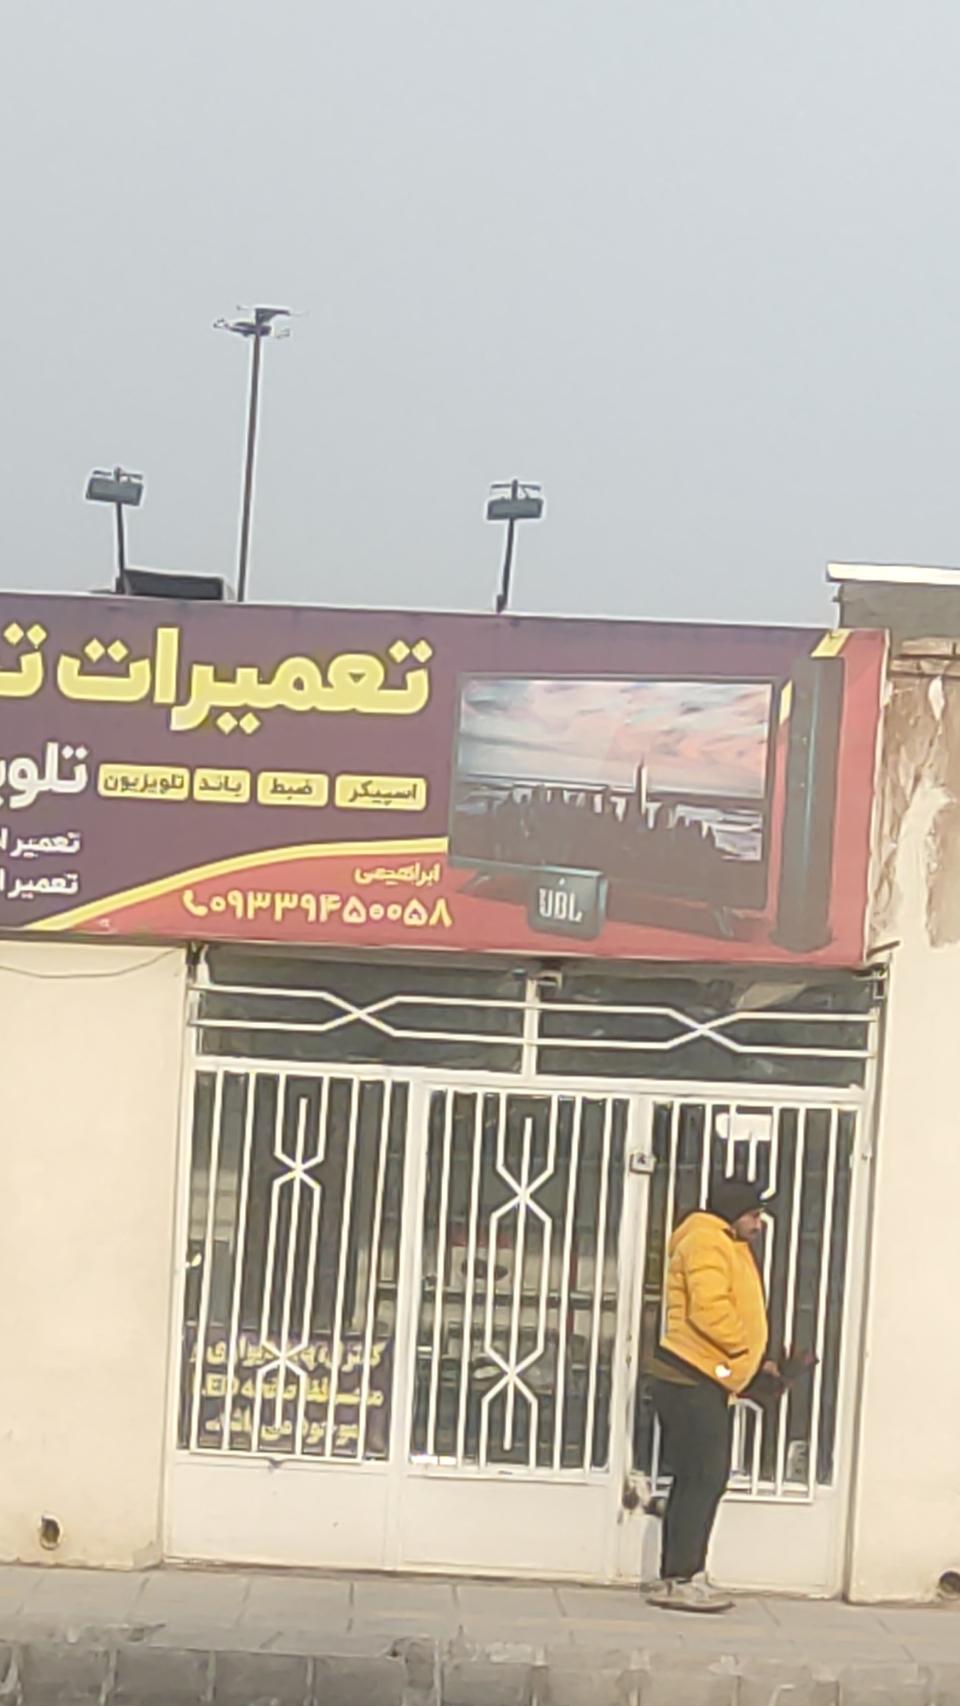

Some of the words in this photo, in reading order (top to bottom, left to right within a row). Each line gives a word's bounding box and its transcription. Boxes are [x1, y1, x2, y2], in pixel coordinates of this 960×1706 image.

[54, 627, 434, 736] تعمیرات
[103, 772, 185, 796] تلویزیون
[198, 775, 243, 797] باند
[269, 777, 314, 800] ضبط
[348, 781, 418, 805] اسپیکر
[9, 831, 82, 858] تعمیر
[7, 873, 79, 899] تعمیر
[353, 862, 441, 887] ابراهیمی
[209, 889, 453, 929] ۰۹۳۳۹۴۵۰۰۵۸
